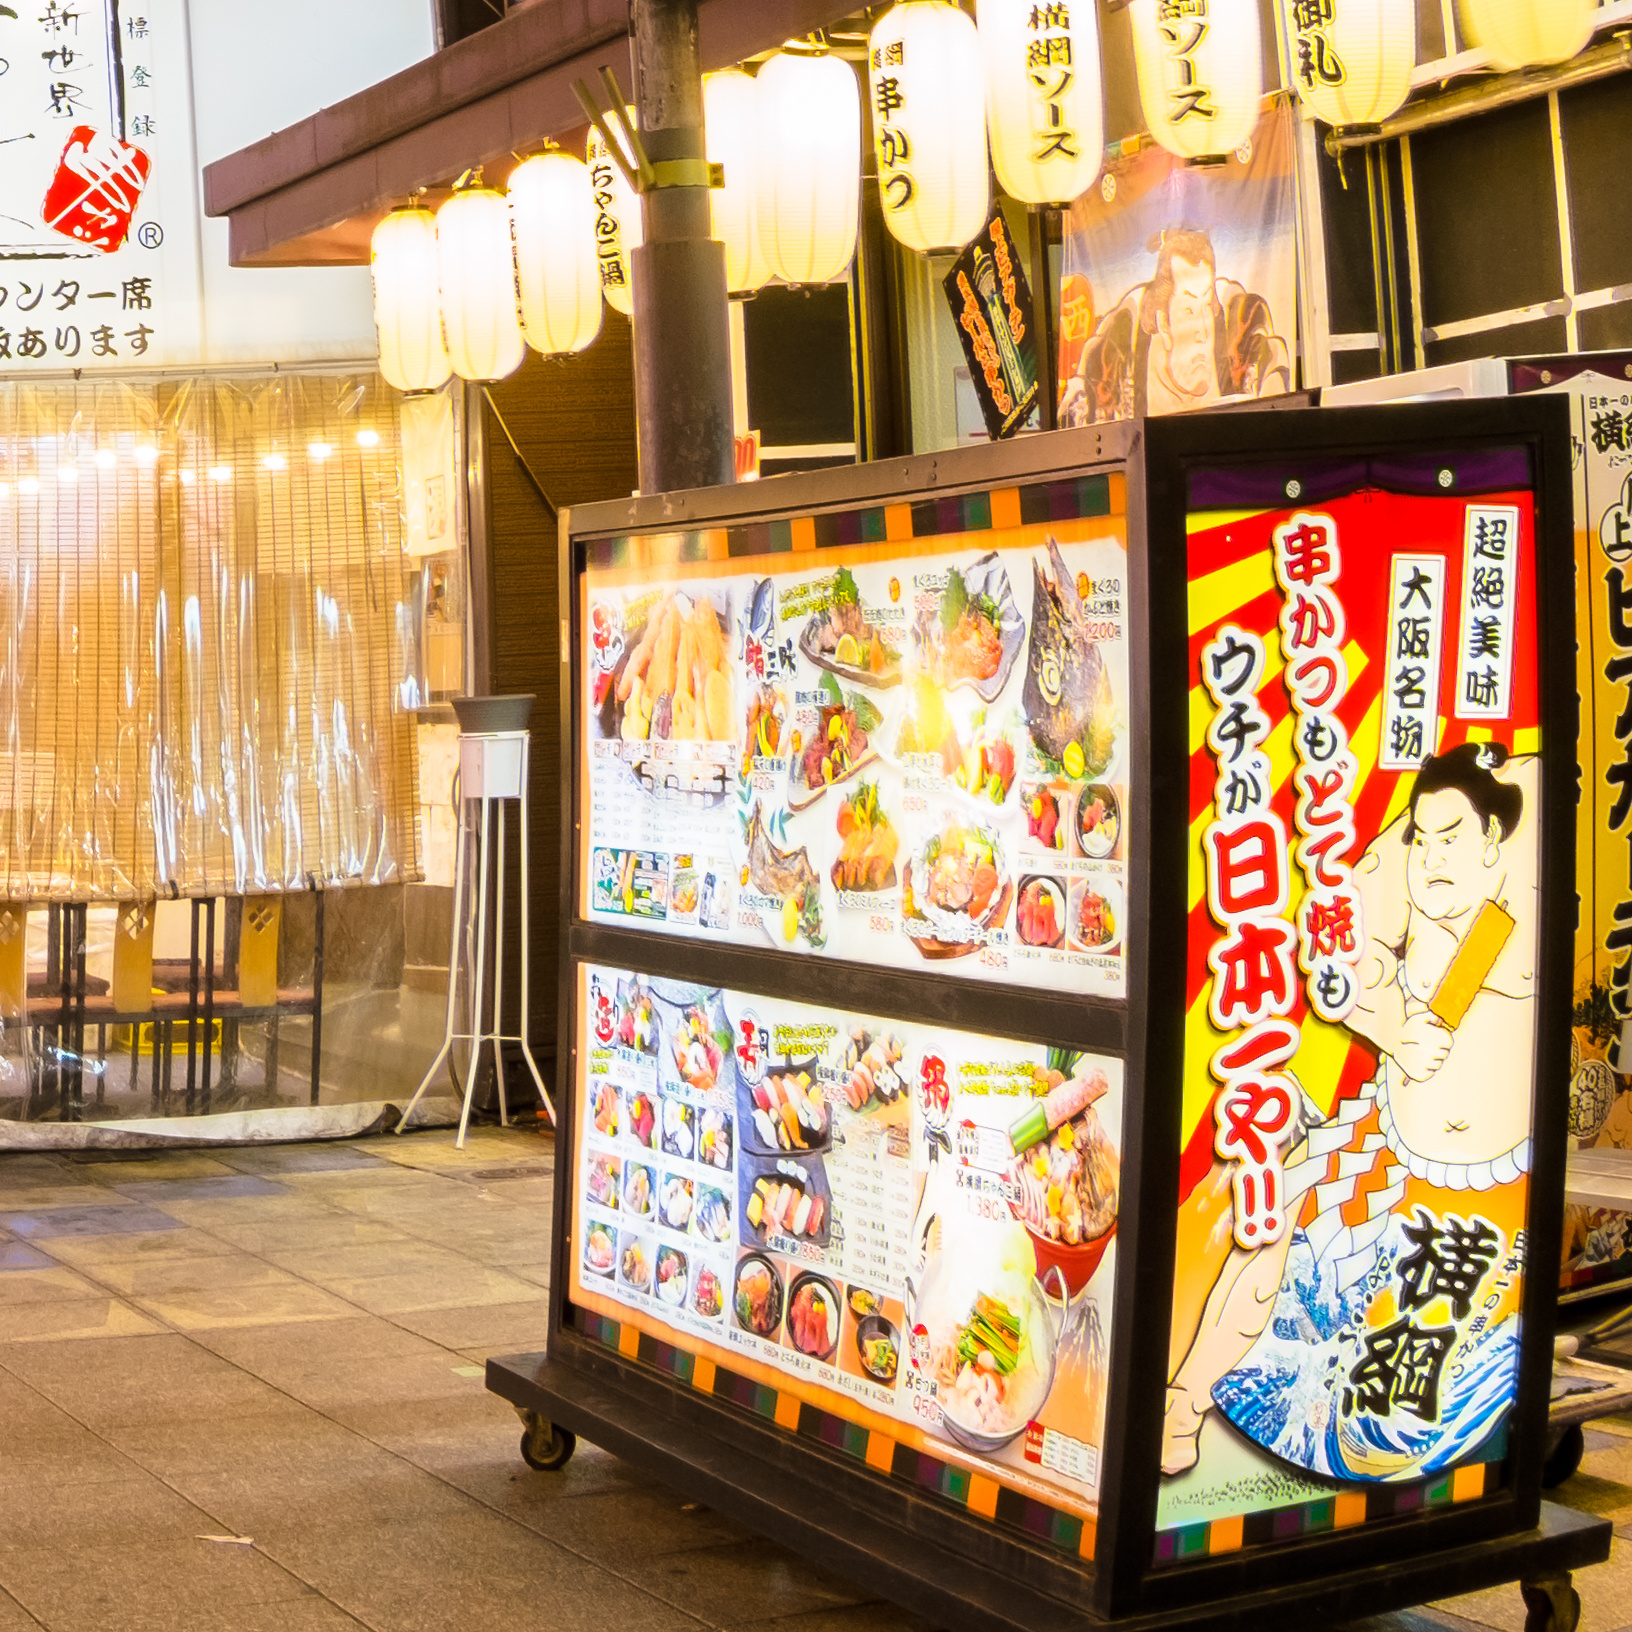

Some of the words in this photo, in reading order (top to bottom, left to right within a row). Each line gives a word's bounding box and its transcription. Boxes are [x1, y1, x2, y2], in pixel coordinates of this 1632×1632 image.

[37, 0, 96, 119] 新世界
[875, 75, 913, 211] 串かつ
[1026, 0, 1079, 162] 横綱ソース
[1390, 566, 1433, 760] 大阪名物
[1468, 518, 1508, 709] 超絶美味
[1283, 520, 1356, 1009] 串かつもどて焼も
[1341, 1208, 1499, 1420] 横綱
